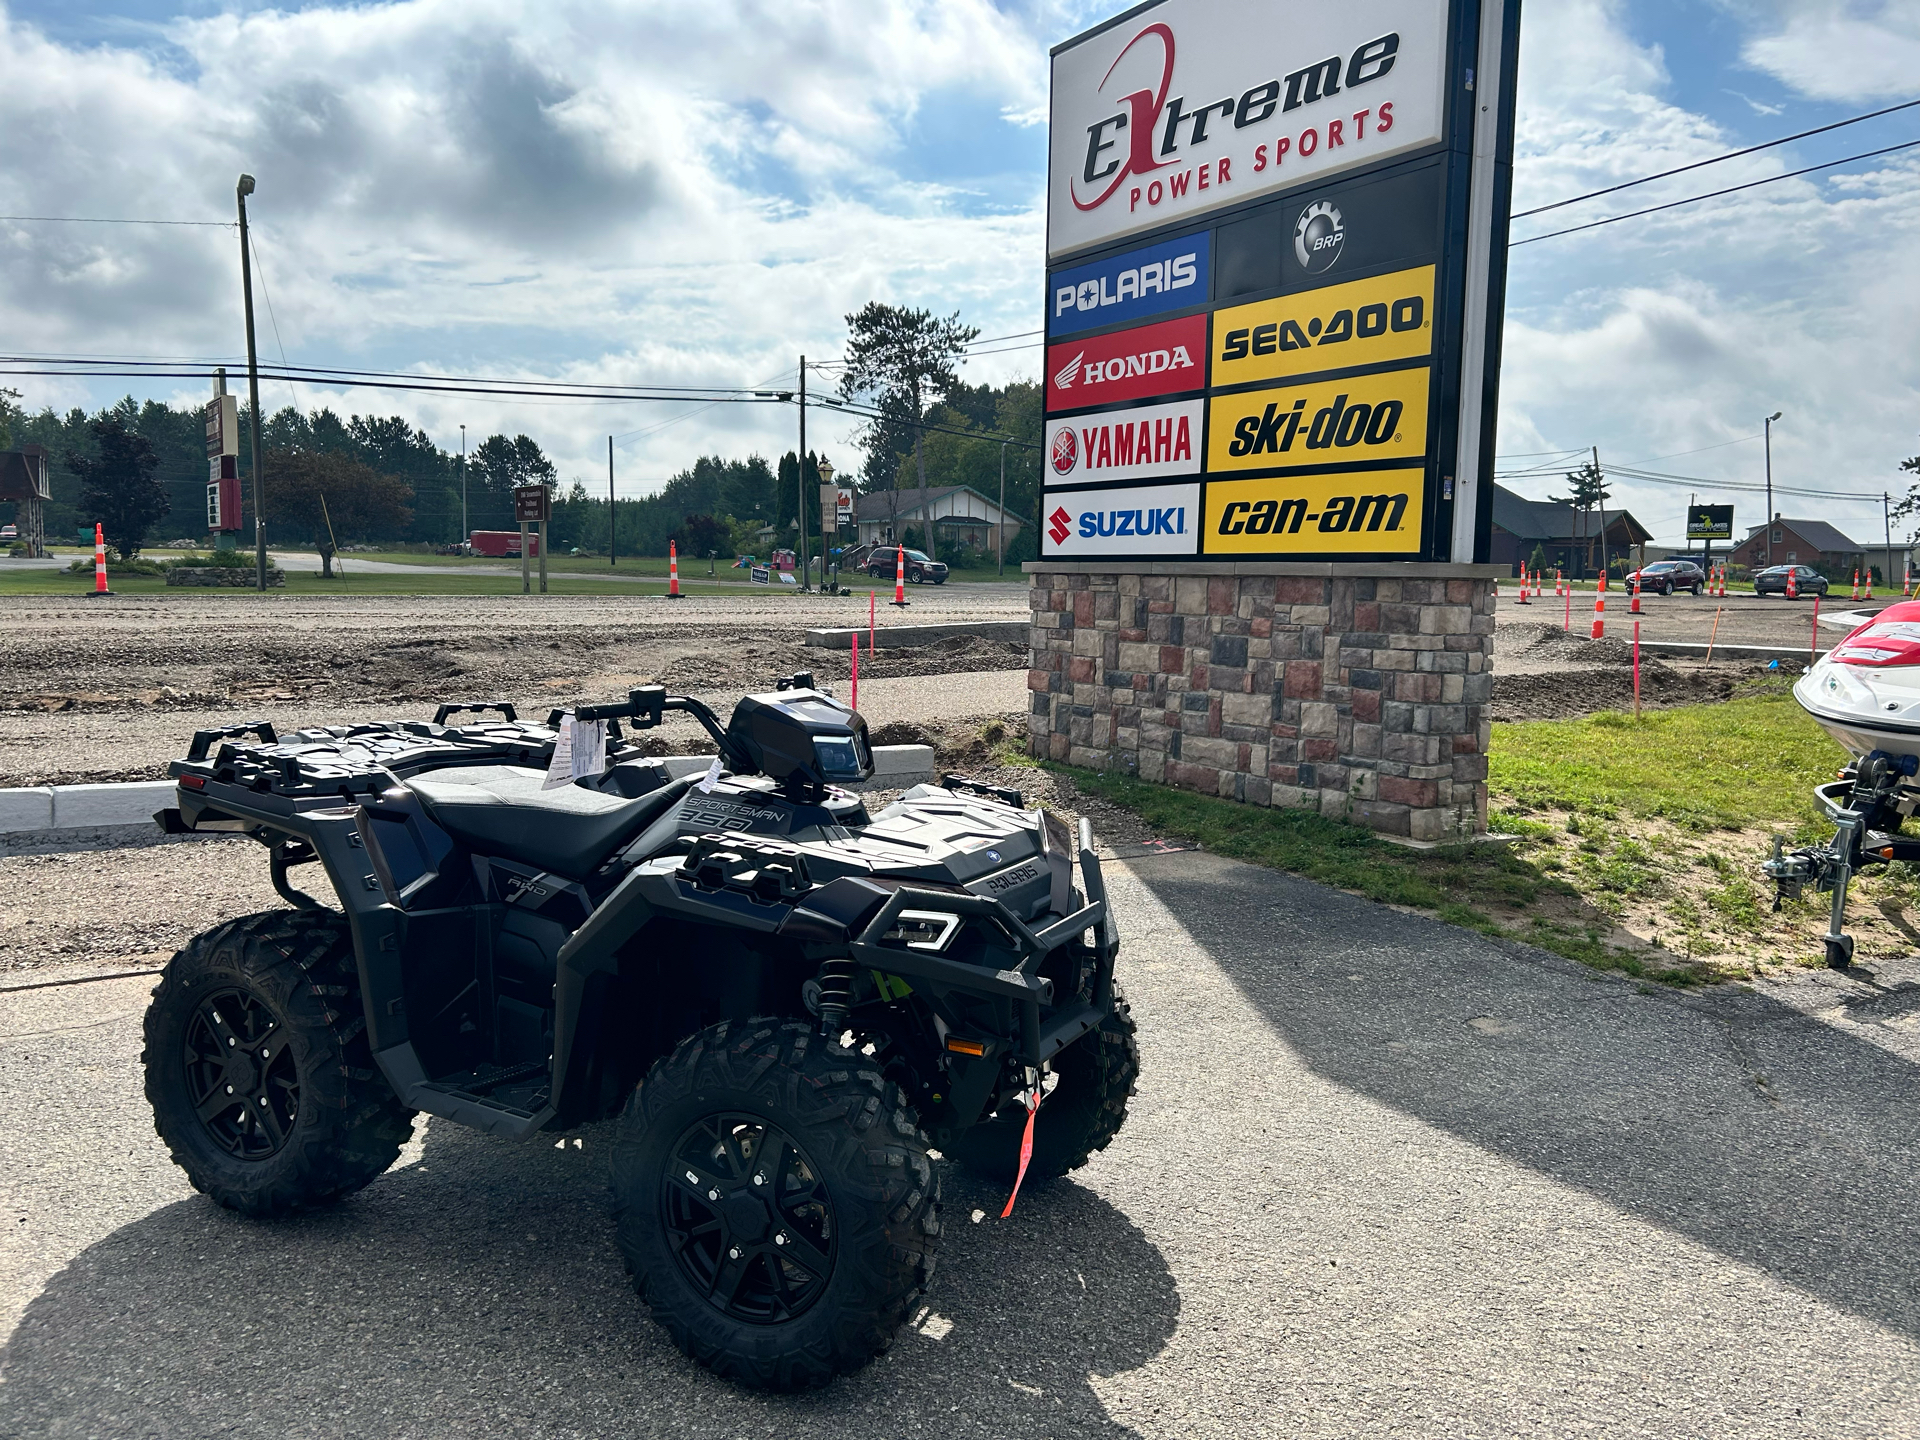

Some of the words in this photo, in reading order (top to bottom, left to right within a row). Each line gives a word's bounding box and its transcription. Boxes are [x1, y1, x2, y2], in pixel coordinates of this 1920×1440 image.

[1130, 157, 1232, 213] POWER
[1253, 101, 1394, 172] SPORTS
[1312, 232, 1344, 251] BRP
[1055, 252, 1197, 318] POLARIS
[1083, 345, 1195, 385] HONDA
[1081, 415, 1192, 470] YAMAHA
[1228, 393, 1404, 458] ski-doo
[1078, 506, 1186, 538] SUZUKI
[1217, 493, 1409, 536] can-am
[685, 797, 785, 822] SPORTSMAN
[507, 878, 548, 896] AWD
[986, 864, 1039, 894] POLARIS
